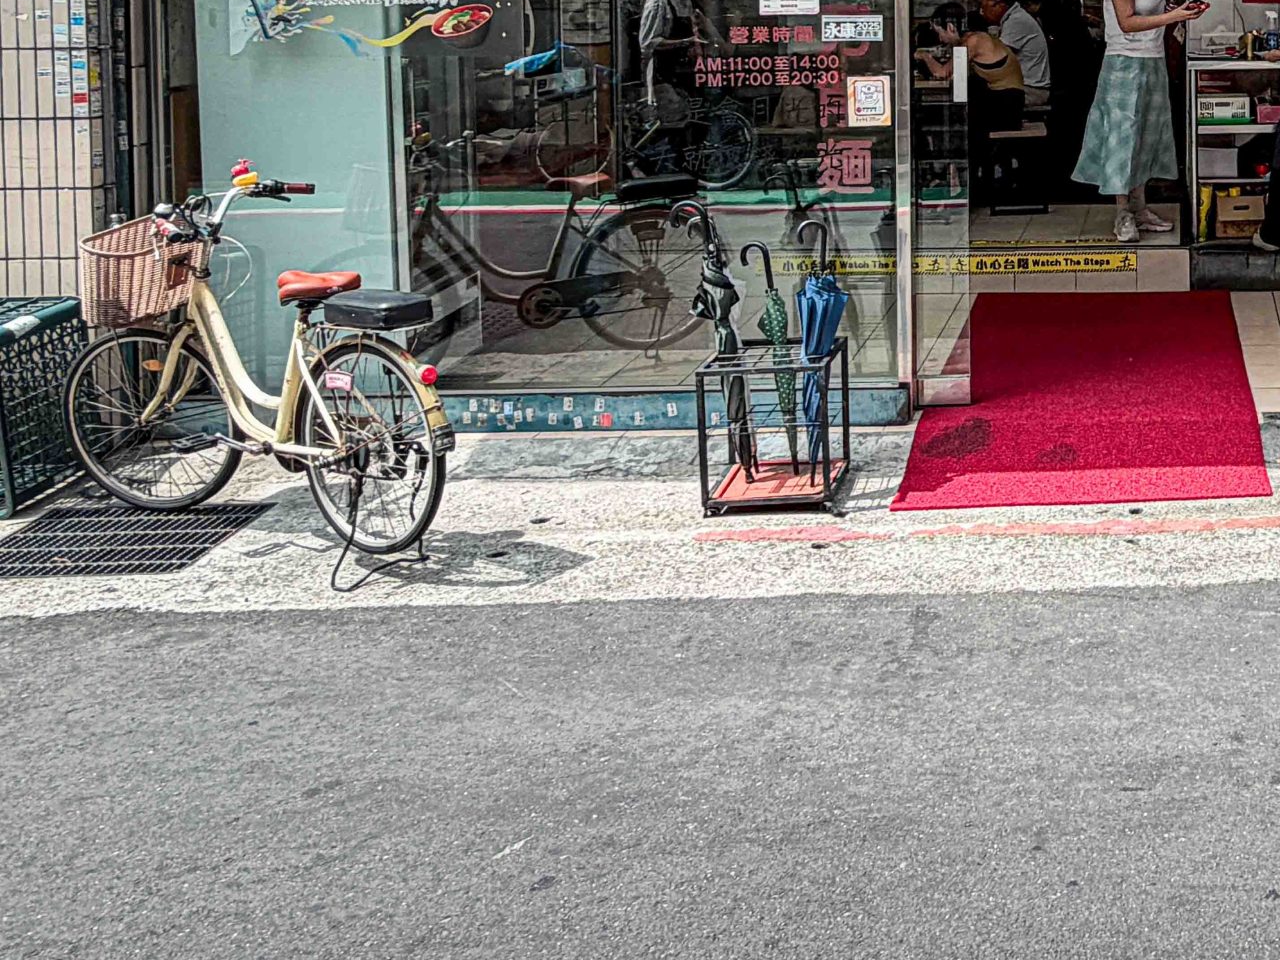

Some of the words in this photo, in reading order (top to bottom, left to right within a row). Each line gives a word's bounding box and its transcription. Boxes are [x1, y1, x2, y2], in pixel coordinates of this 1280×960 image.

[729, 25, 814, 44] 營業時間
[824, 22, 856, 38] 永康
[856, 22, 880, 30] 2025
[694, 55, 839, 72] AM:11:00至14:00
[695, 71, 839, 87] PM:17:00至20:30
[839, 260, 869, 269] Watch
[873, 259, 890, 269] The
[975, 258, 1030, 270] 小心台階
[1032, 258, 1061, 267] Watch
[1063, 257, 1081, 266] The
